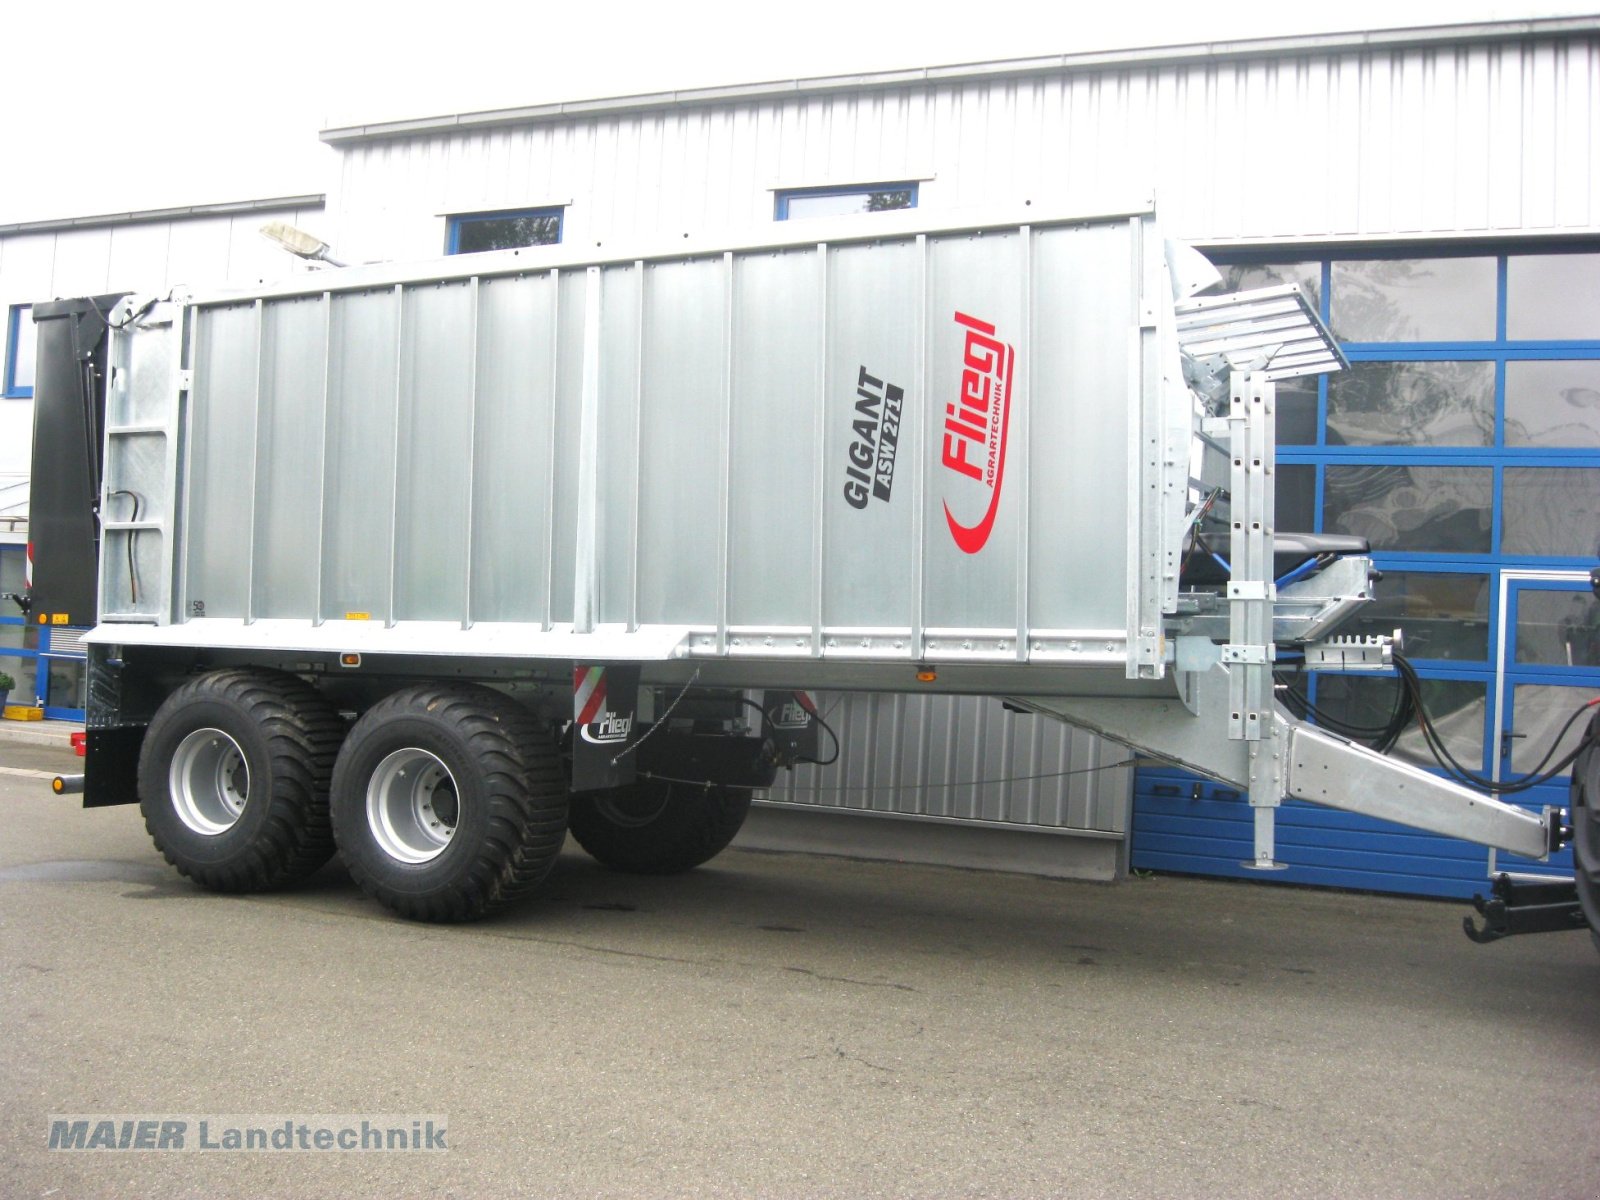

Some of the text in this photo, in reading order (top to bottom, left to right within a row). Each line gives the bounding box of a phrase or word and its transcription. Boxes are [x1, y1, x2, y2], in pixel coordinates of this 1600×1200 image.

[844, 365, 884, 509] GIGANT
[876, 398, 902, 490] ASW 271
[942, 311, 1005, 481] Fliegl
[987, 382, 1002, 488] AGRARTECHNIK
